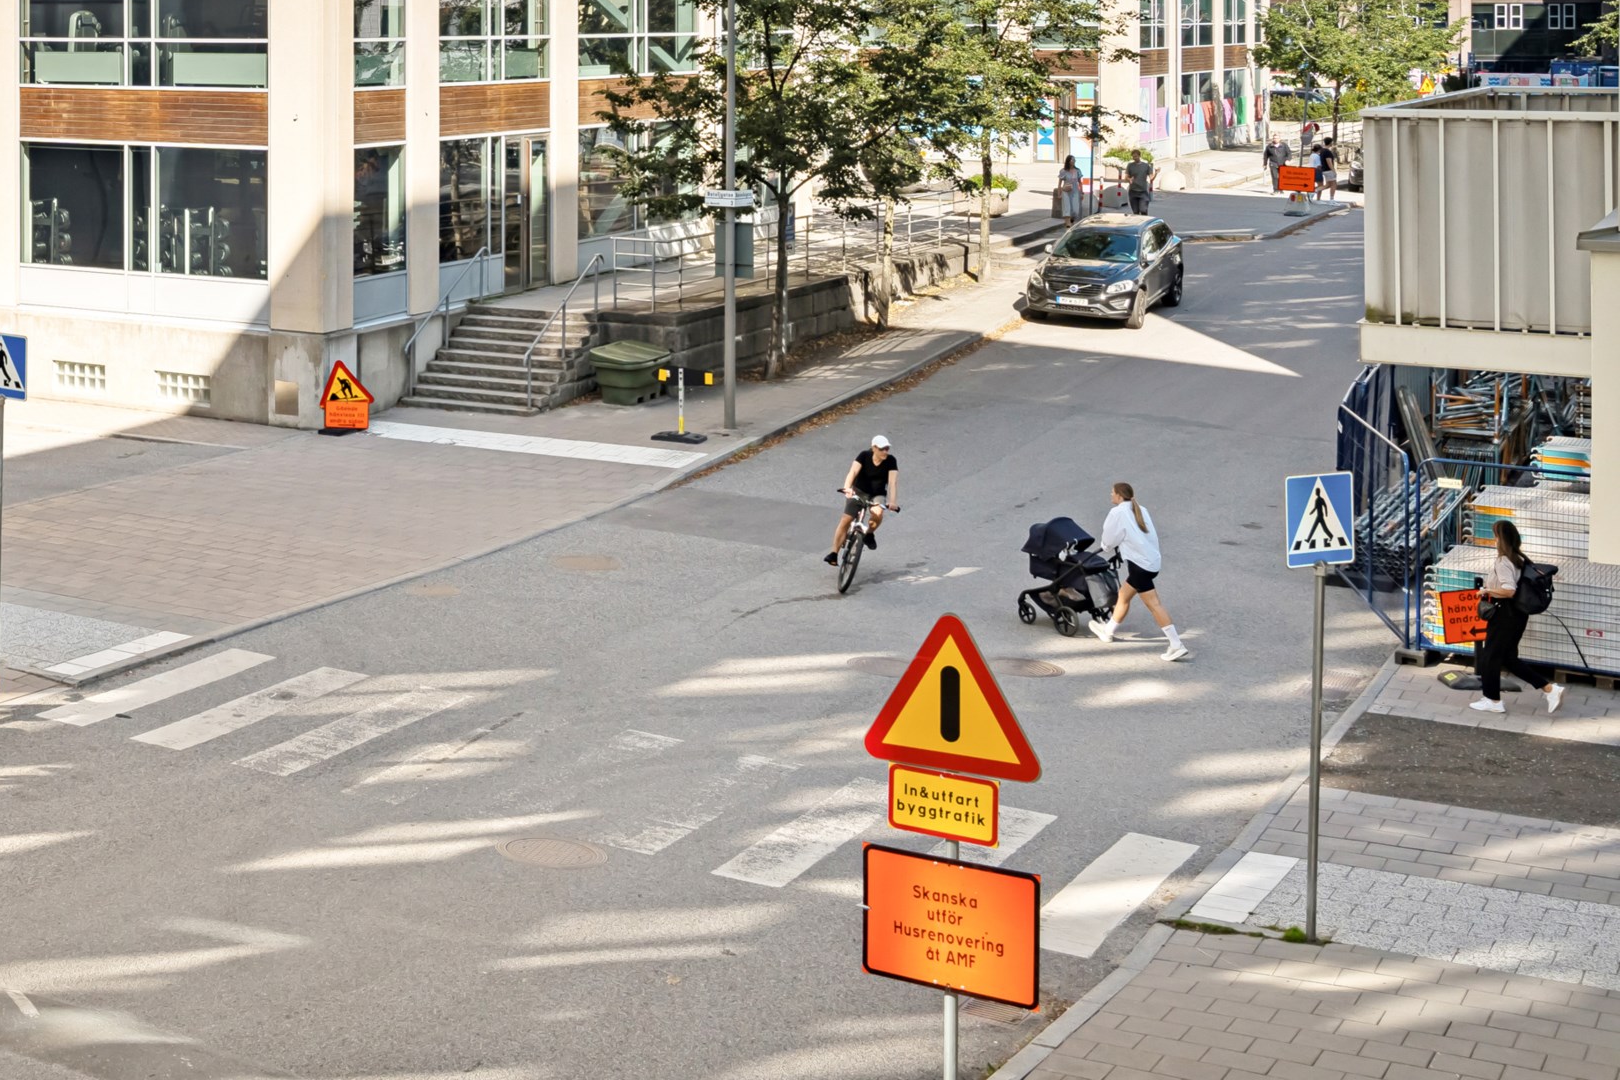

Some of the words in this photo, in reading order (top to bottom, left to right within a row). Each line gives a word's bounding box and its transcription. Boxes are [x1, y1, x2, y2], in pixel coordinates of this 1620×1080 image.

[904, 783, 979, 808] In&utfart
[896, 798, 985, 827] byggtrafik
[912, 884, 978, 909] Skanska
[927, 908, 963, 926] utför
[893, 920, 1004, 958] Husrenovering
[926, 946, 940, 961] åt
[946, 950, 976, 968] AMF
